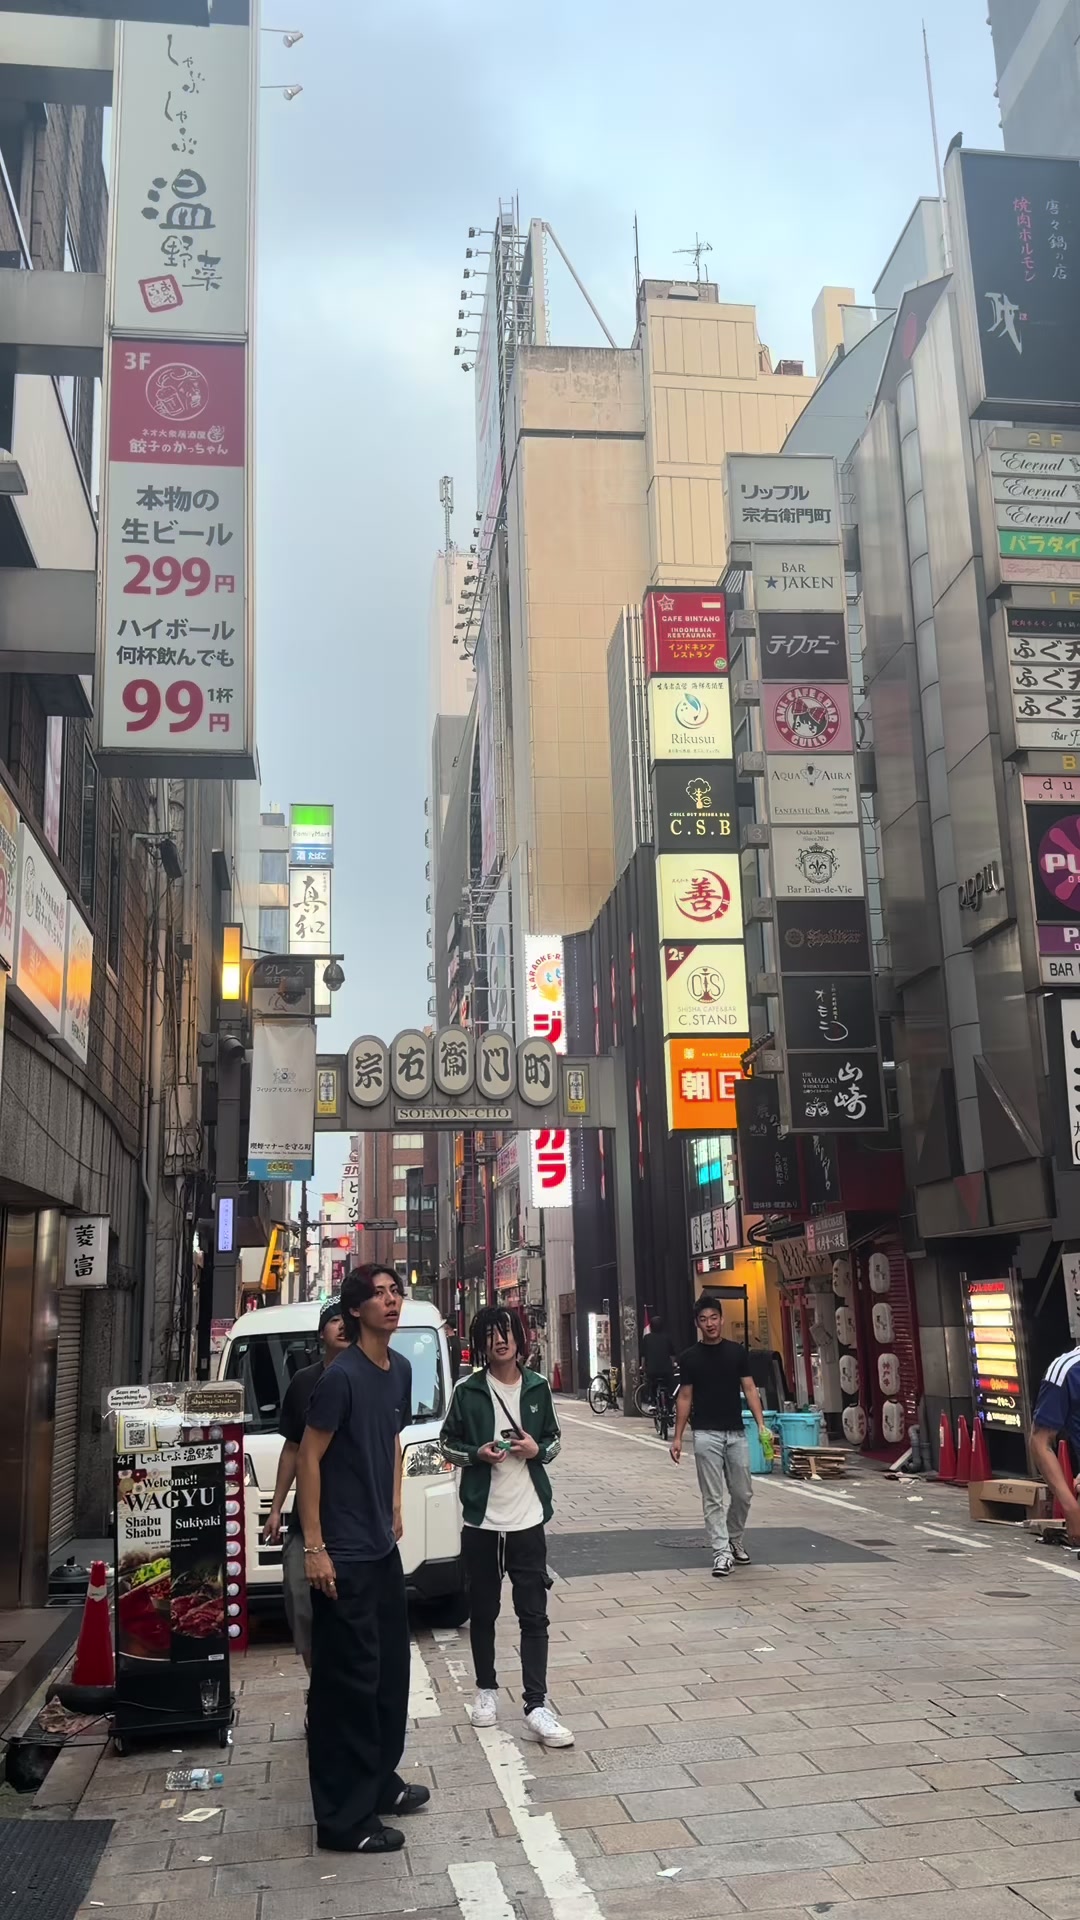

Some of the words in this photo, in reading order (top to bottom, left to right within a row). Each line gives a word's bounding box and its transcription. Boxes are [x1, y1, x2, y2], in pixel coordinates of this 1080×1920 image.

[164, 34, 206, 155] しゃぶしゃぶ
[141, 168, 222, 291] 温野菜
[1013, 196, 1036, 283] 焼肉ホルモン
[124, 352, 151, 370] 3F
[129, 438, 228, 455] 餃子のかっちゃん
[1000, 452, 1065, 471] Eternal
[741, 484, 810, 501] リップル
[1003, 478, 1068, 498] Eternal
[136, 485, 220, 513] 本物の
[742, 507, 832, 524] 宗右衛門町
[1006, 505, 1071, 525] Eternal
[121, 518, 234, 546] 生ビール
[122, 554, 235, 597] 299円
[782, 576, 834, 592] JAKEN
[117, 617, 235, 641] ハイボール
[668, 643, 715, 651] インドネシア
[673, 651, 711, 659] レストラン
[766, 635, 840, 658] ティファニー
[117, 644, 235, 668] 何杯飲んでも
[206, 687, 234, 704] 1杯
[671, 732, 716, 745] Rikusui
[790, 734, 828, 748] GUILD
[292, 829, 330, 838] FamilyMart
[670, 819, 731, 836] C.S.B
[295, 850, 306, 861] 酒
[307, 851, 328, 860] たばこ
[678, 876, 723, 913] 善
[786, 885, 802, 894] Bar
[804, 885, 853, 894] Eau-de-Vie
[296, 875, 328, 939] 真和
[668, 947, 685, 961] 2F
[1049, 962, 1074, 977] BAR
[678, 1014, 738, 1026] C.STAND
[354, 1041, 551, 1090] 宗右衛門町
[833, 1061, 868, 1120] 山崎
[399, 1108, 510, 1119] SOEMON-CHO
[249, 1142, 312, 1151] 喫煙マナーを守る町
[73, 1223, 96, 1278] 菱富
[116, 1455, 135, 1466] 4F
[140, 1450, 181, 1465] しゃぶしゃぶ
[183, 1447, 215, 1462] 温野菜
[143, 1474, 198, 1488] Welcome!!
[125, 1486, 217, 1513] WAGYU
[125, 1515, 162, 1528] Shabu
[175, 1515, 221, 1531] Sukiyaki
[125, 1527, 162, 1540] Shabu
